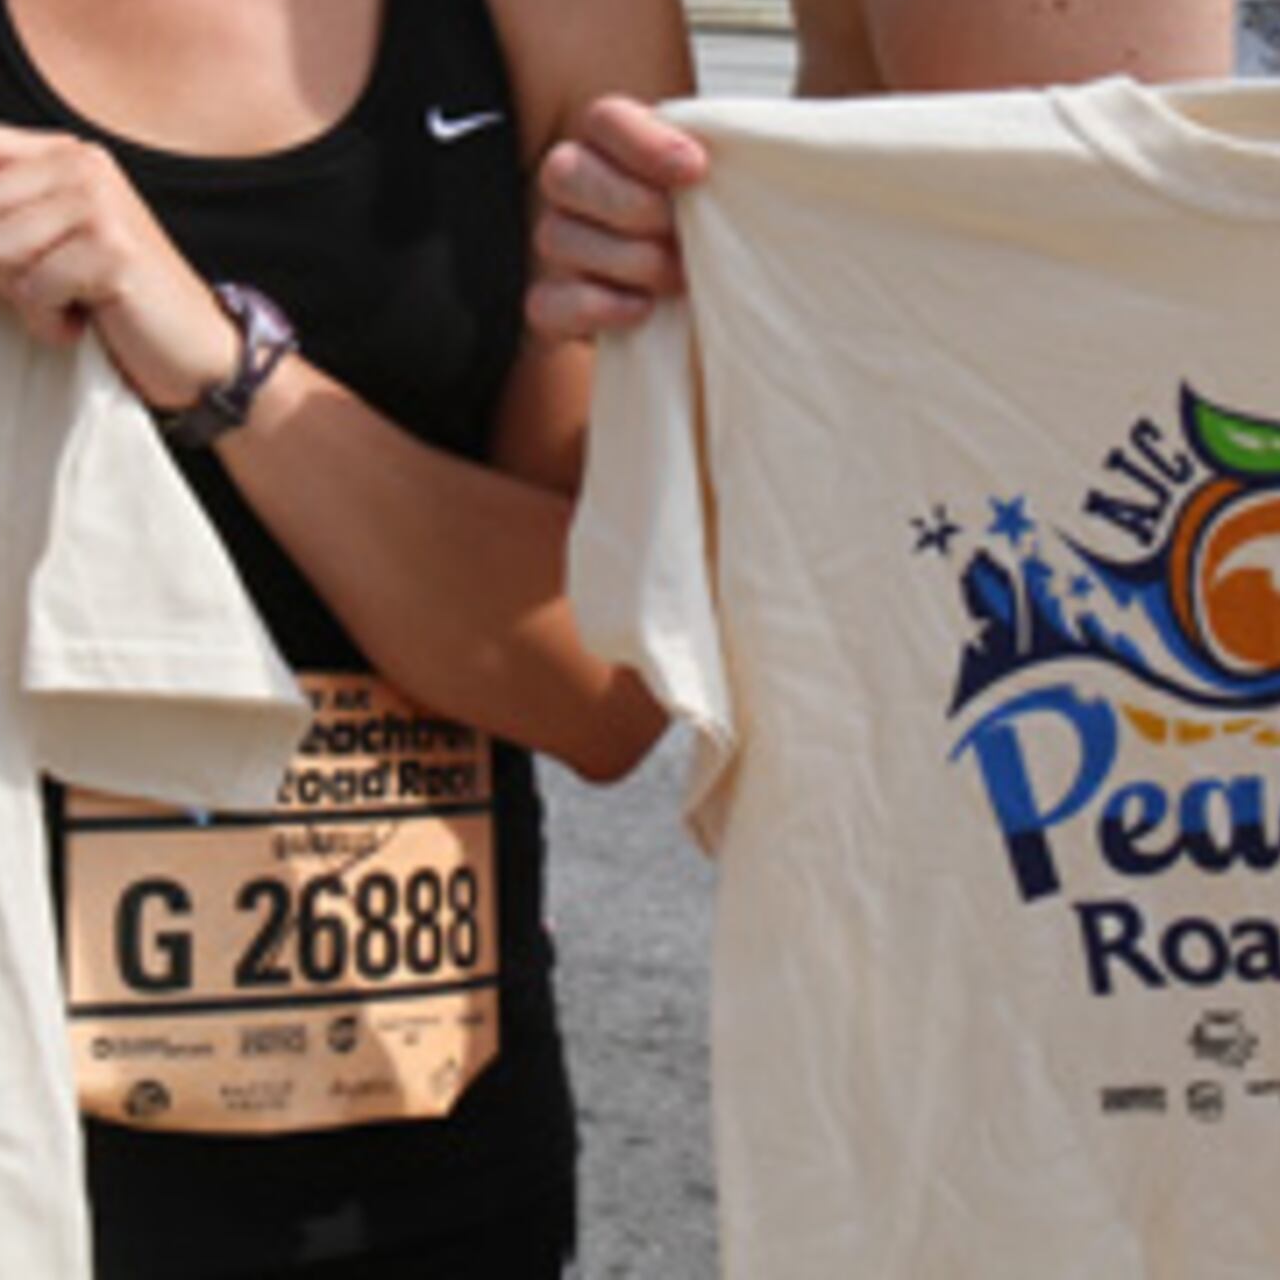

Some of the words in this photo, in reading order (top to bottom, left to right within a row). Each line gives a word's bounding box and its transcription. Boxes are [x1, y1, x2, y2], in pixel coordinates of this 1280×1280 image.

[1082, 416, 1195, 547] AJC
[114, 875, 194, 997] G
[233, 865, 481, 990] 26888
